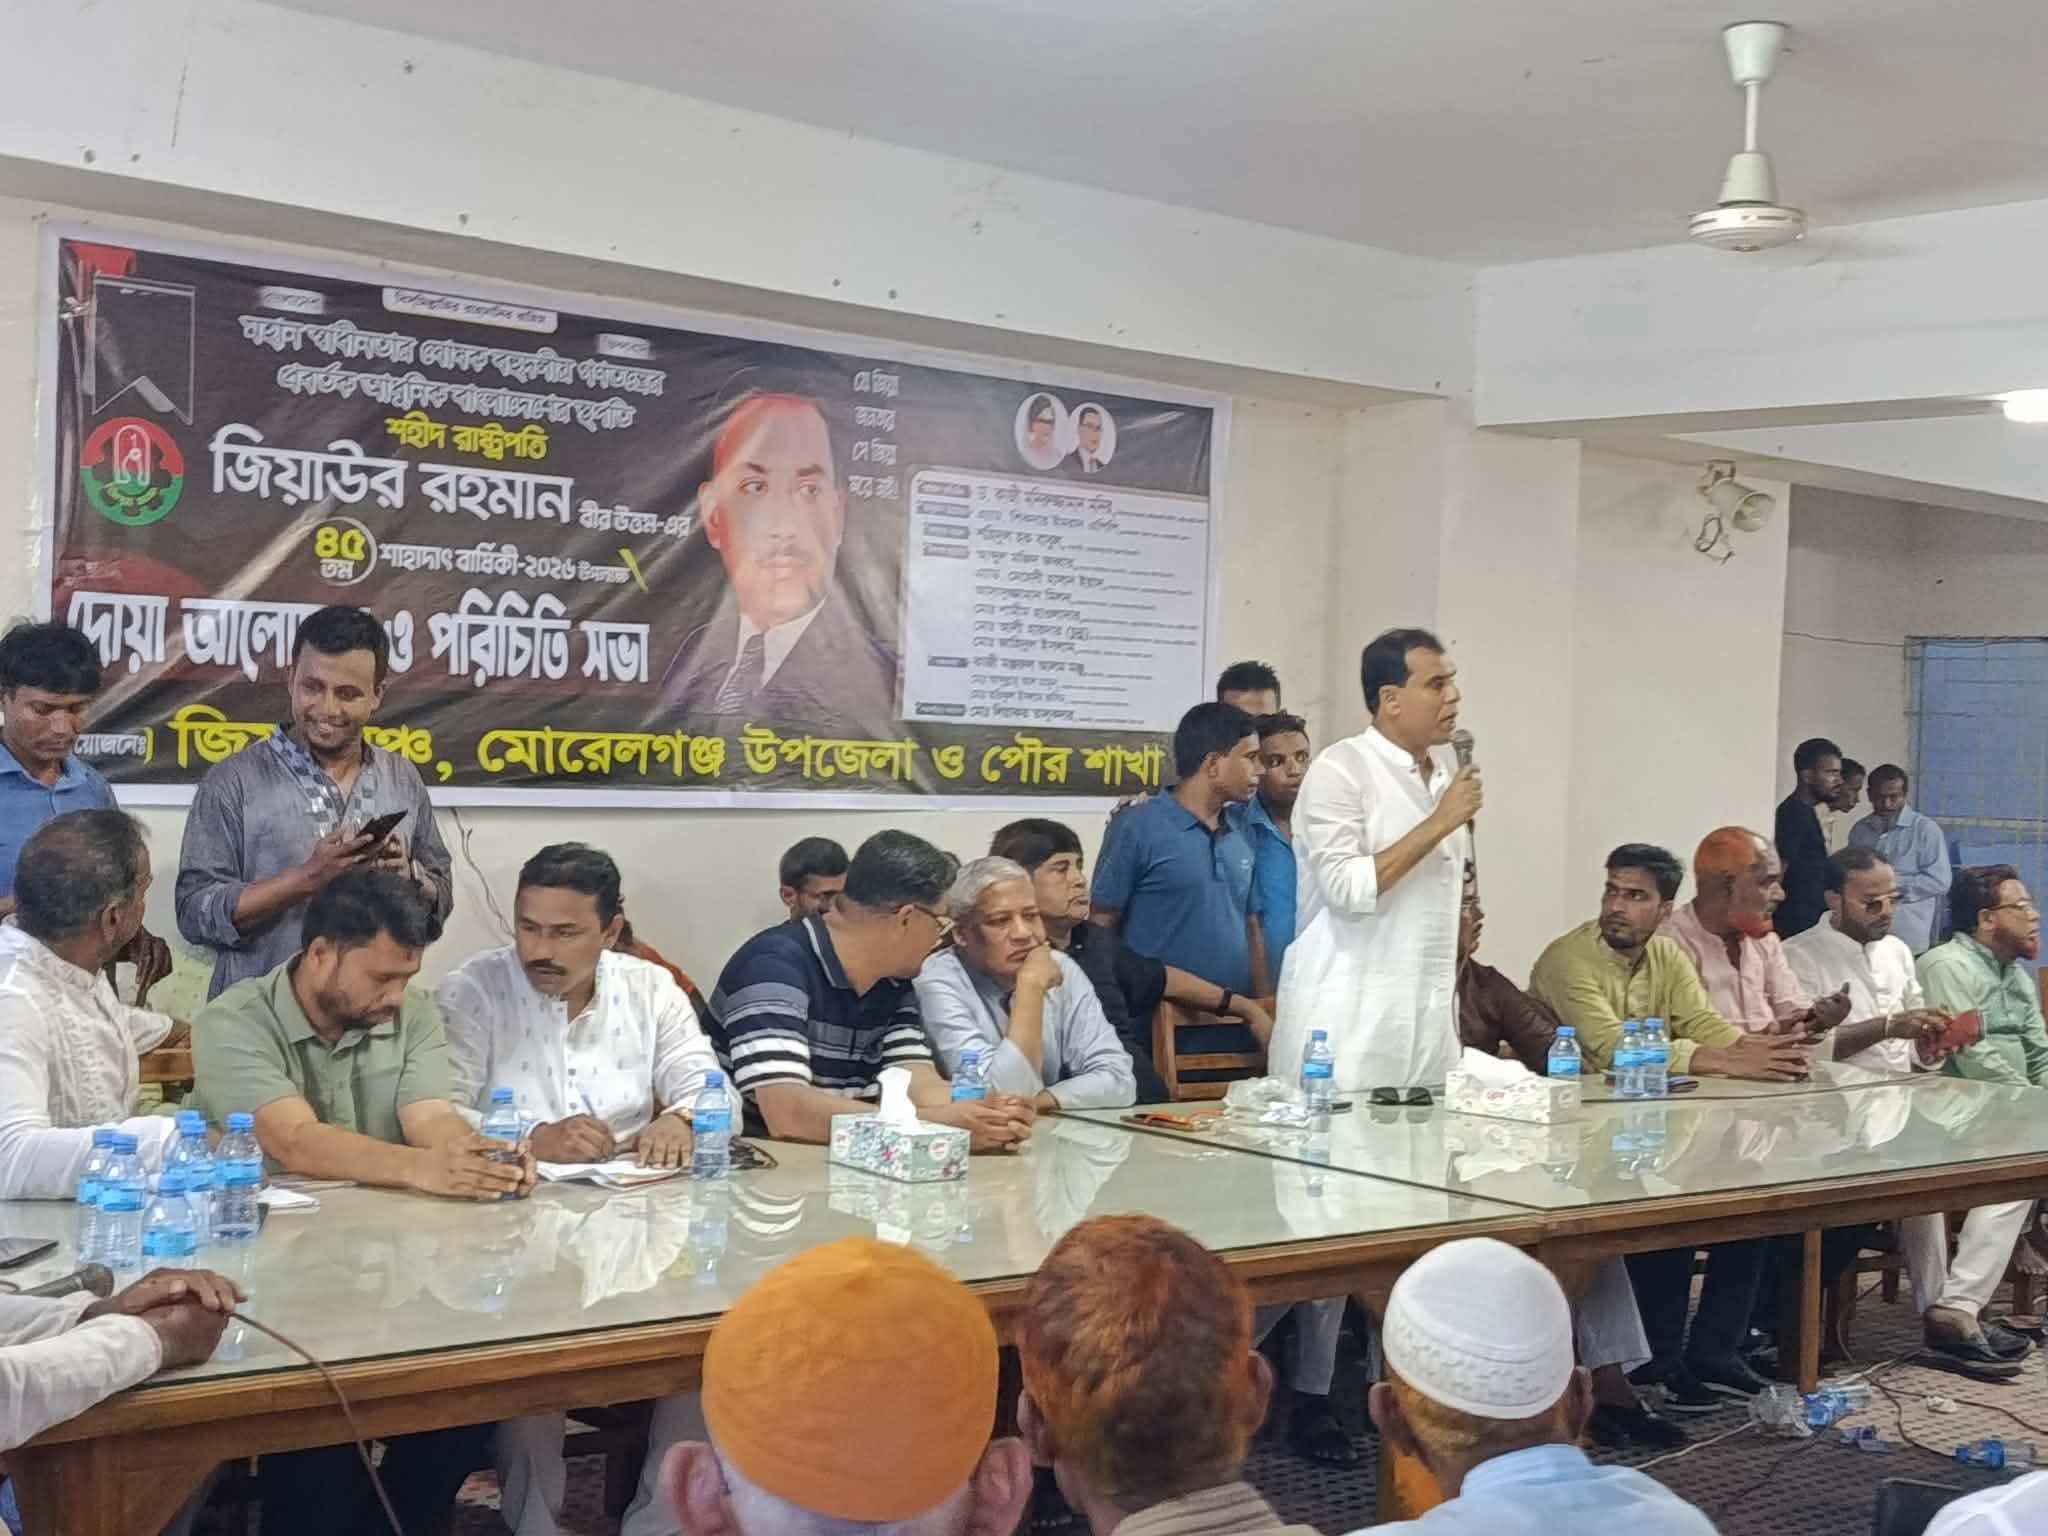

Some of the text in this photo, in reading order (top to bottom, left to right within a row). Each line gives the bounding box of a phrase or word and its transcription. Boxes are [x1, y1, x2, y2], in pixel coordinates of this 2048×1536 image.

[384, 410, 549, 461] শহীদ রাষ্ট্রপতি
[209, 422, 408, 509] জিয়াউর
[417, 462, 575, 525] রহমান
[578, 500, 612, 531] বীর
[314, 527, 366, 561] ৪৫
[319, 558, 355, 580] তম
[378, 543, 453, 573] শাহাদাৎ
[66, 591, 170, 674] দোয়া
[427, 588, 571, 688] পরিচিতি
[579, 620, 650, 683] সভা
[477, 725, 725, 778] মোরেলগঞ্জ
[740, 722, 918, 781] উপজেলা
[932, 743, 965, 779] ও
[981, 730, 1071, 785] পৌর
[1080, 742, 1165, 787] শাখা
